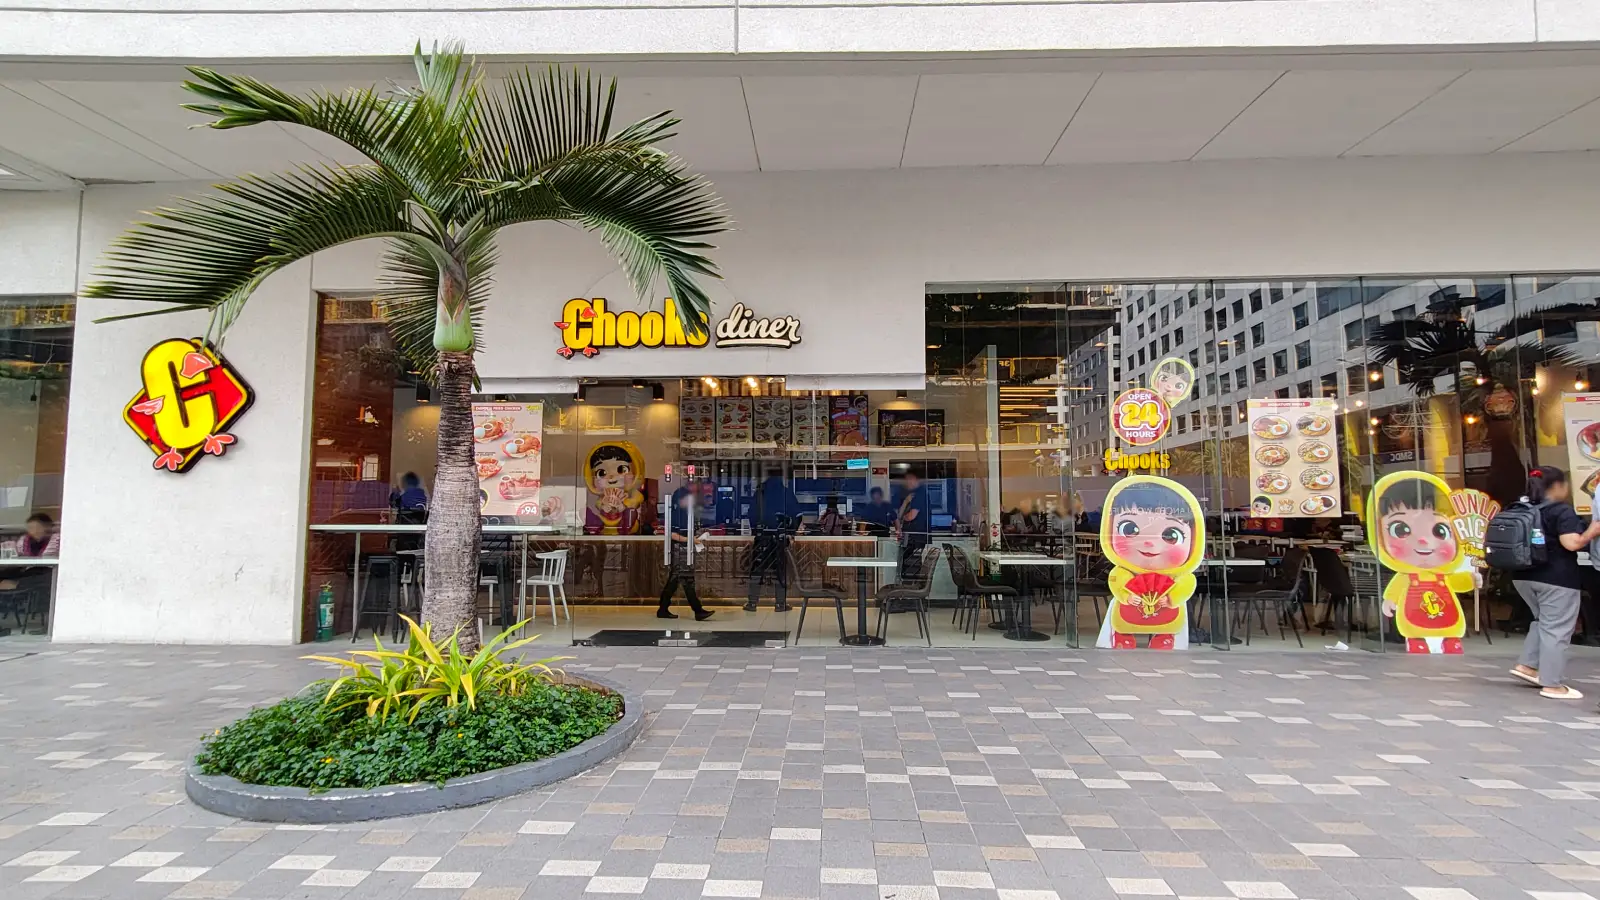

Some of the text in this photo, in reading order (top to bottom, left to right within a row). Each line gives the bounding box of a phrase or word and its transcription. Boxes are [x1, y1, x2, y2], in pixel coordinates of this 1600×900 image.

[715, 302, 801, 348] diner
[1120, 401, 1163, 430] 24
[1125, 430, 1156, 438] HOURS
[1104, 448, 1171, 471] Chooks
[1451, 493, 1500, 521] UNLI
[1453, 517, 1486, 541] RIC
